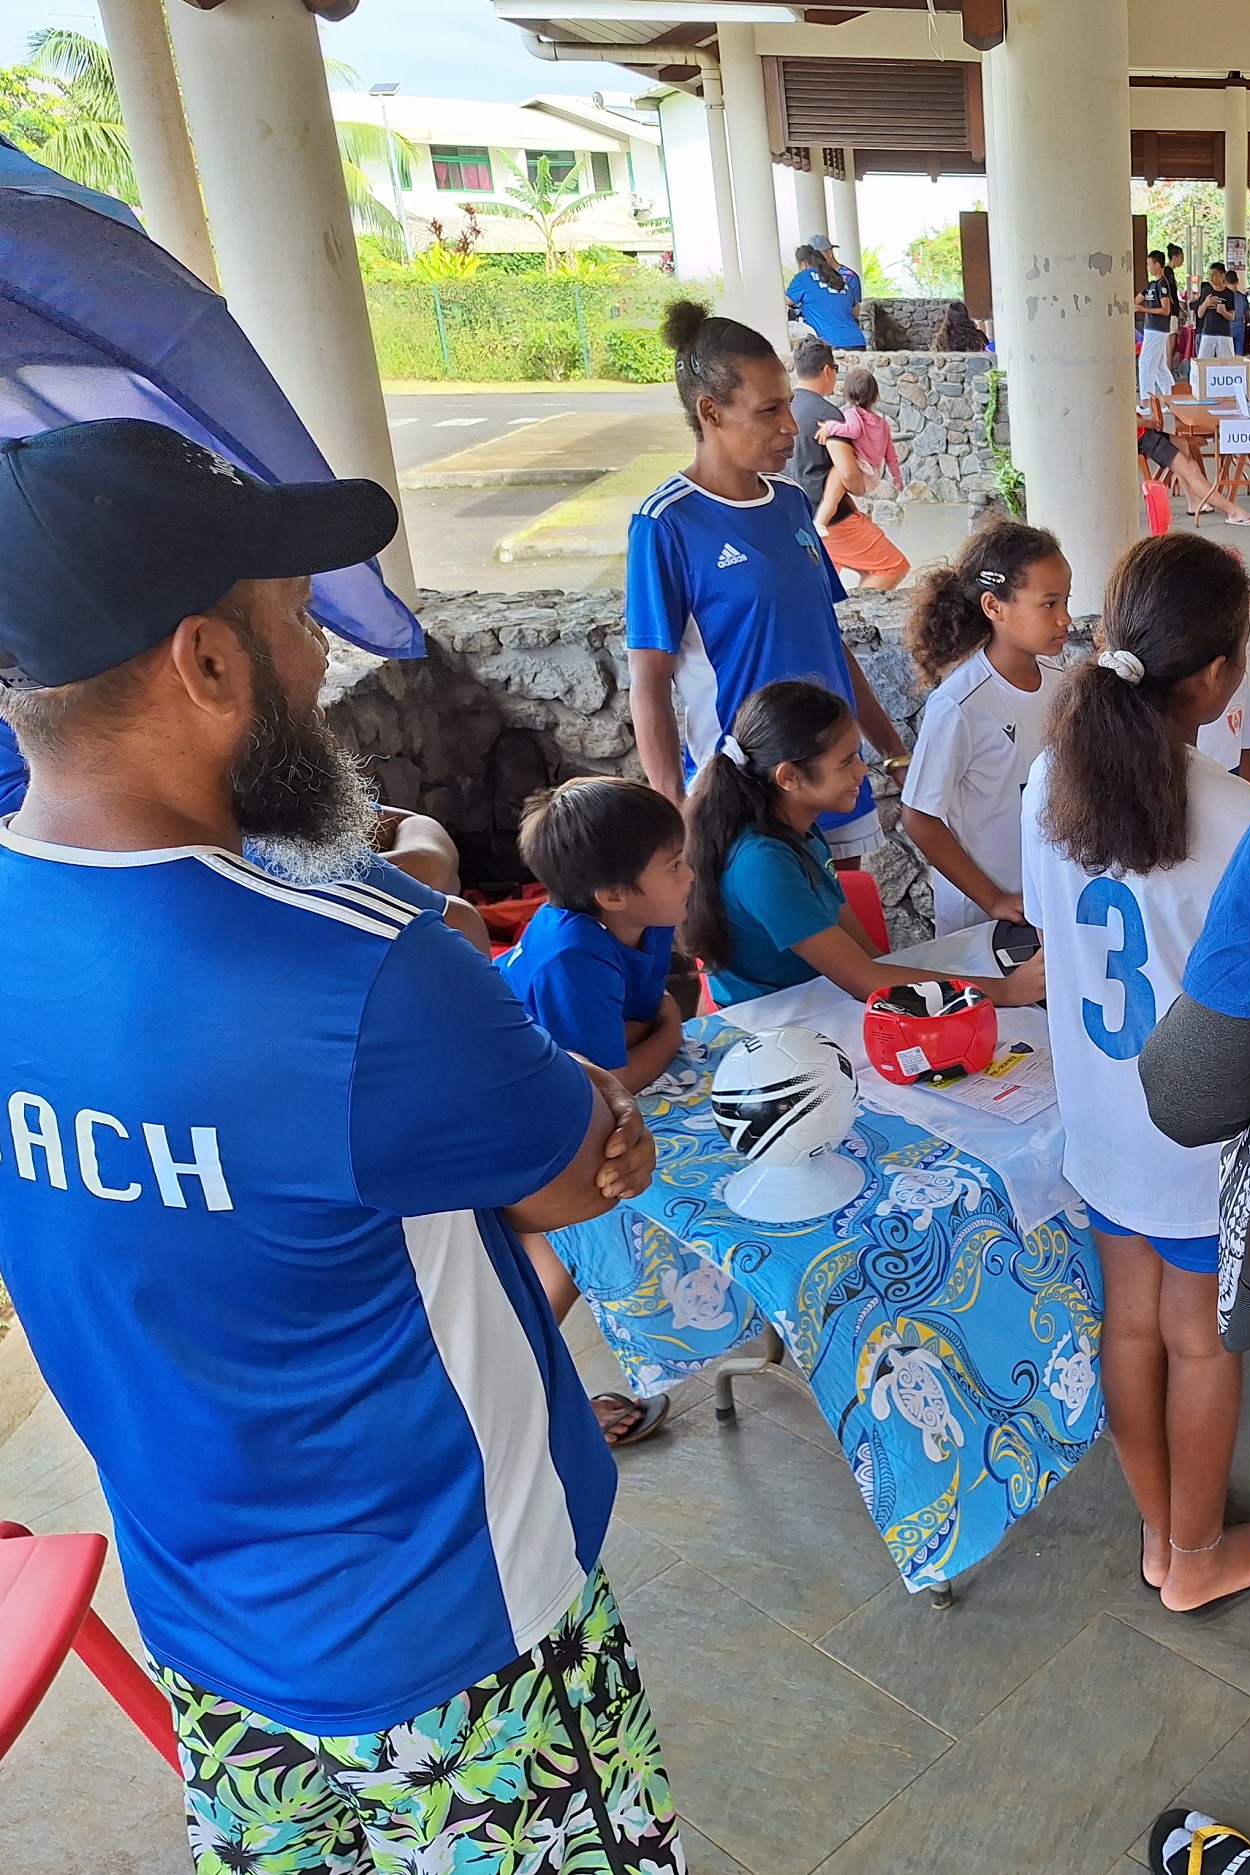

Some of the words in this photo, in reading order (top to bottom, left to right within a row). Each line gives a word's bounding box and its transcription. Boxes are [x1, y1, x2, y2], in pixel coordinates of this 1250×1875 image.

[1210, 375, 1243, 387] JUDO
[717, 553, 748, 569] adidas
[1075, 876, 1157, 1061] 3
[0, 1090, 234, 1212] ACH
